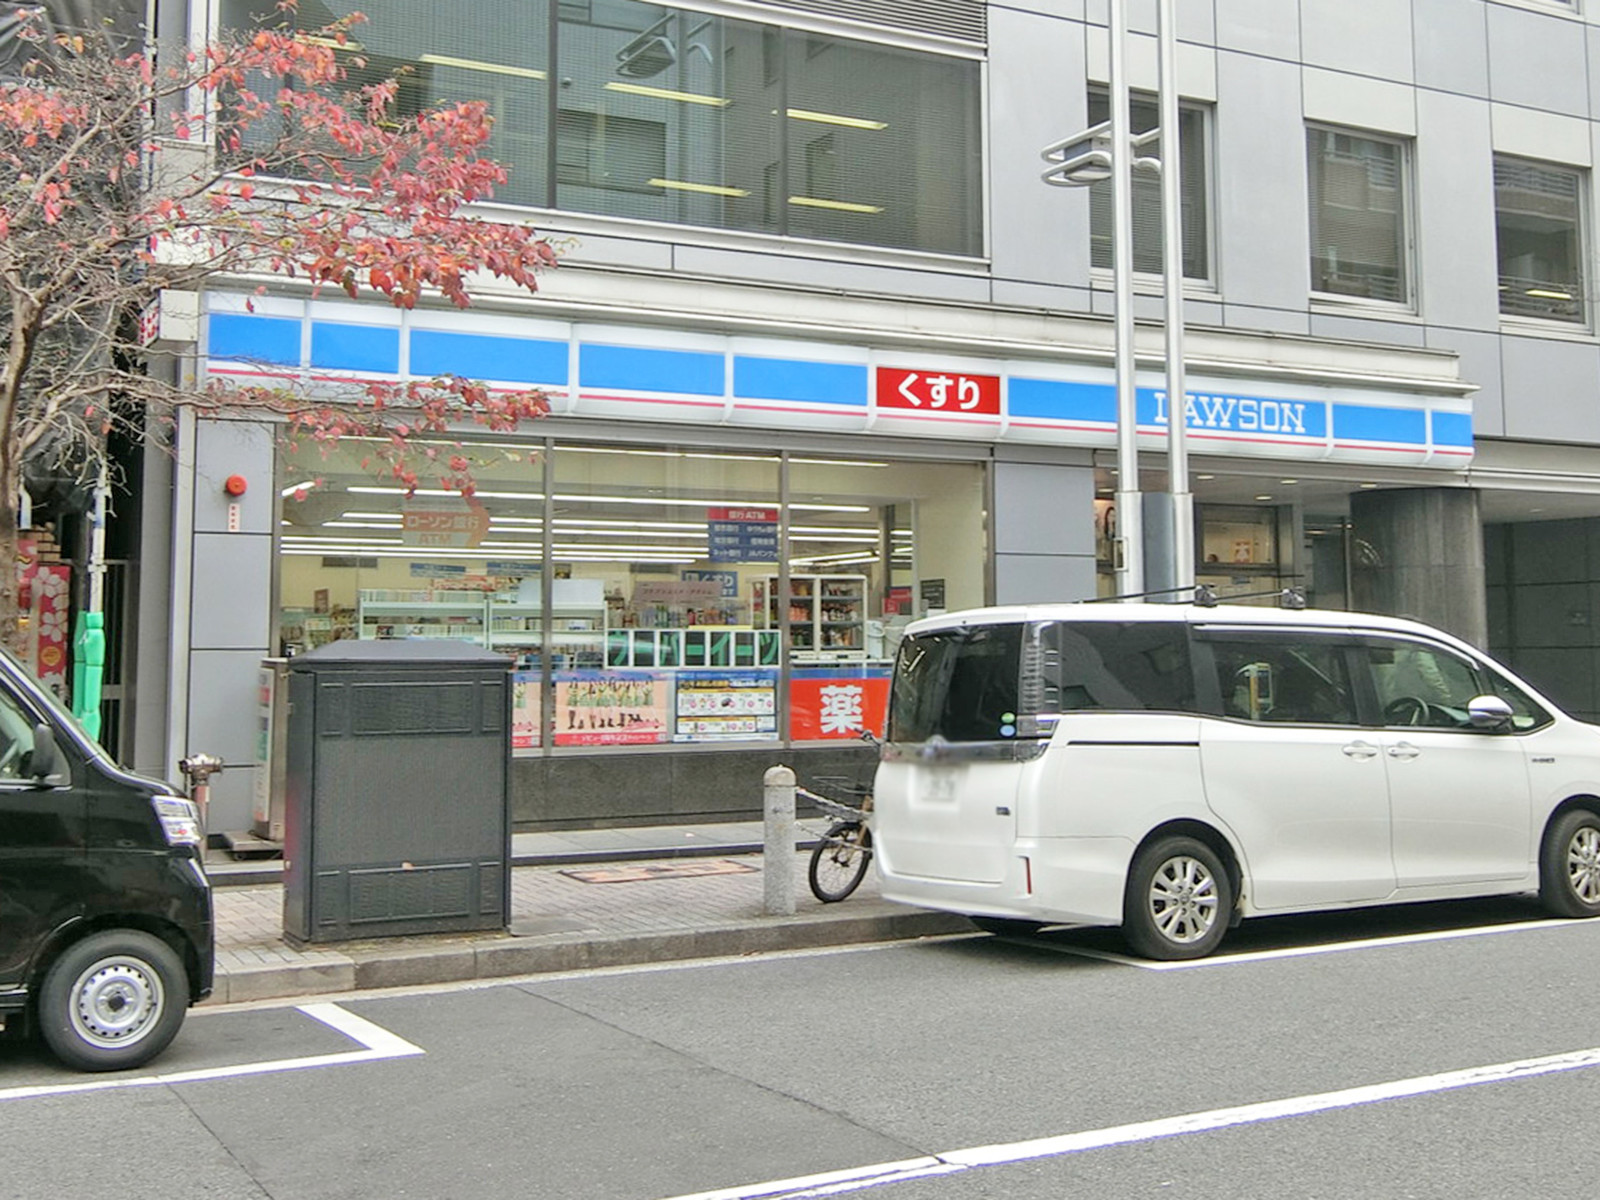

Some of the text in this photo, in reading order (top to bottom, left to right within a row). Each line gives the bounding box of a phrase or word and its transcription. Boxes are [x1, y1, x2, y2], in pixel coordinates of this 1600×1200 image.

[897, 372, 980, 410] くすり
[1153, 392, 1306, 434] LAWSON
[407, 515, 480, 529] ローソン銀行
[819, 684, 864, 734] 薬
